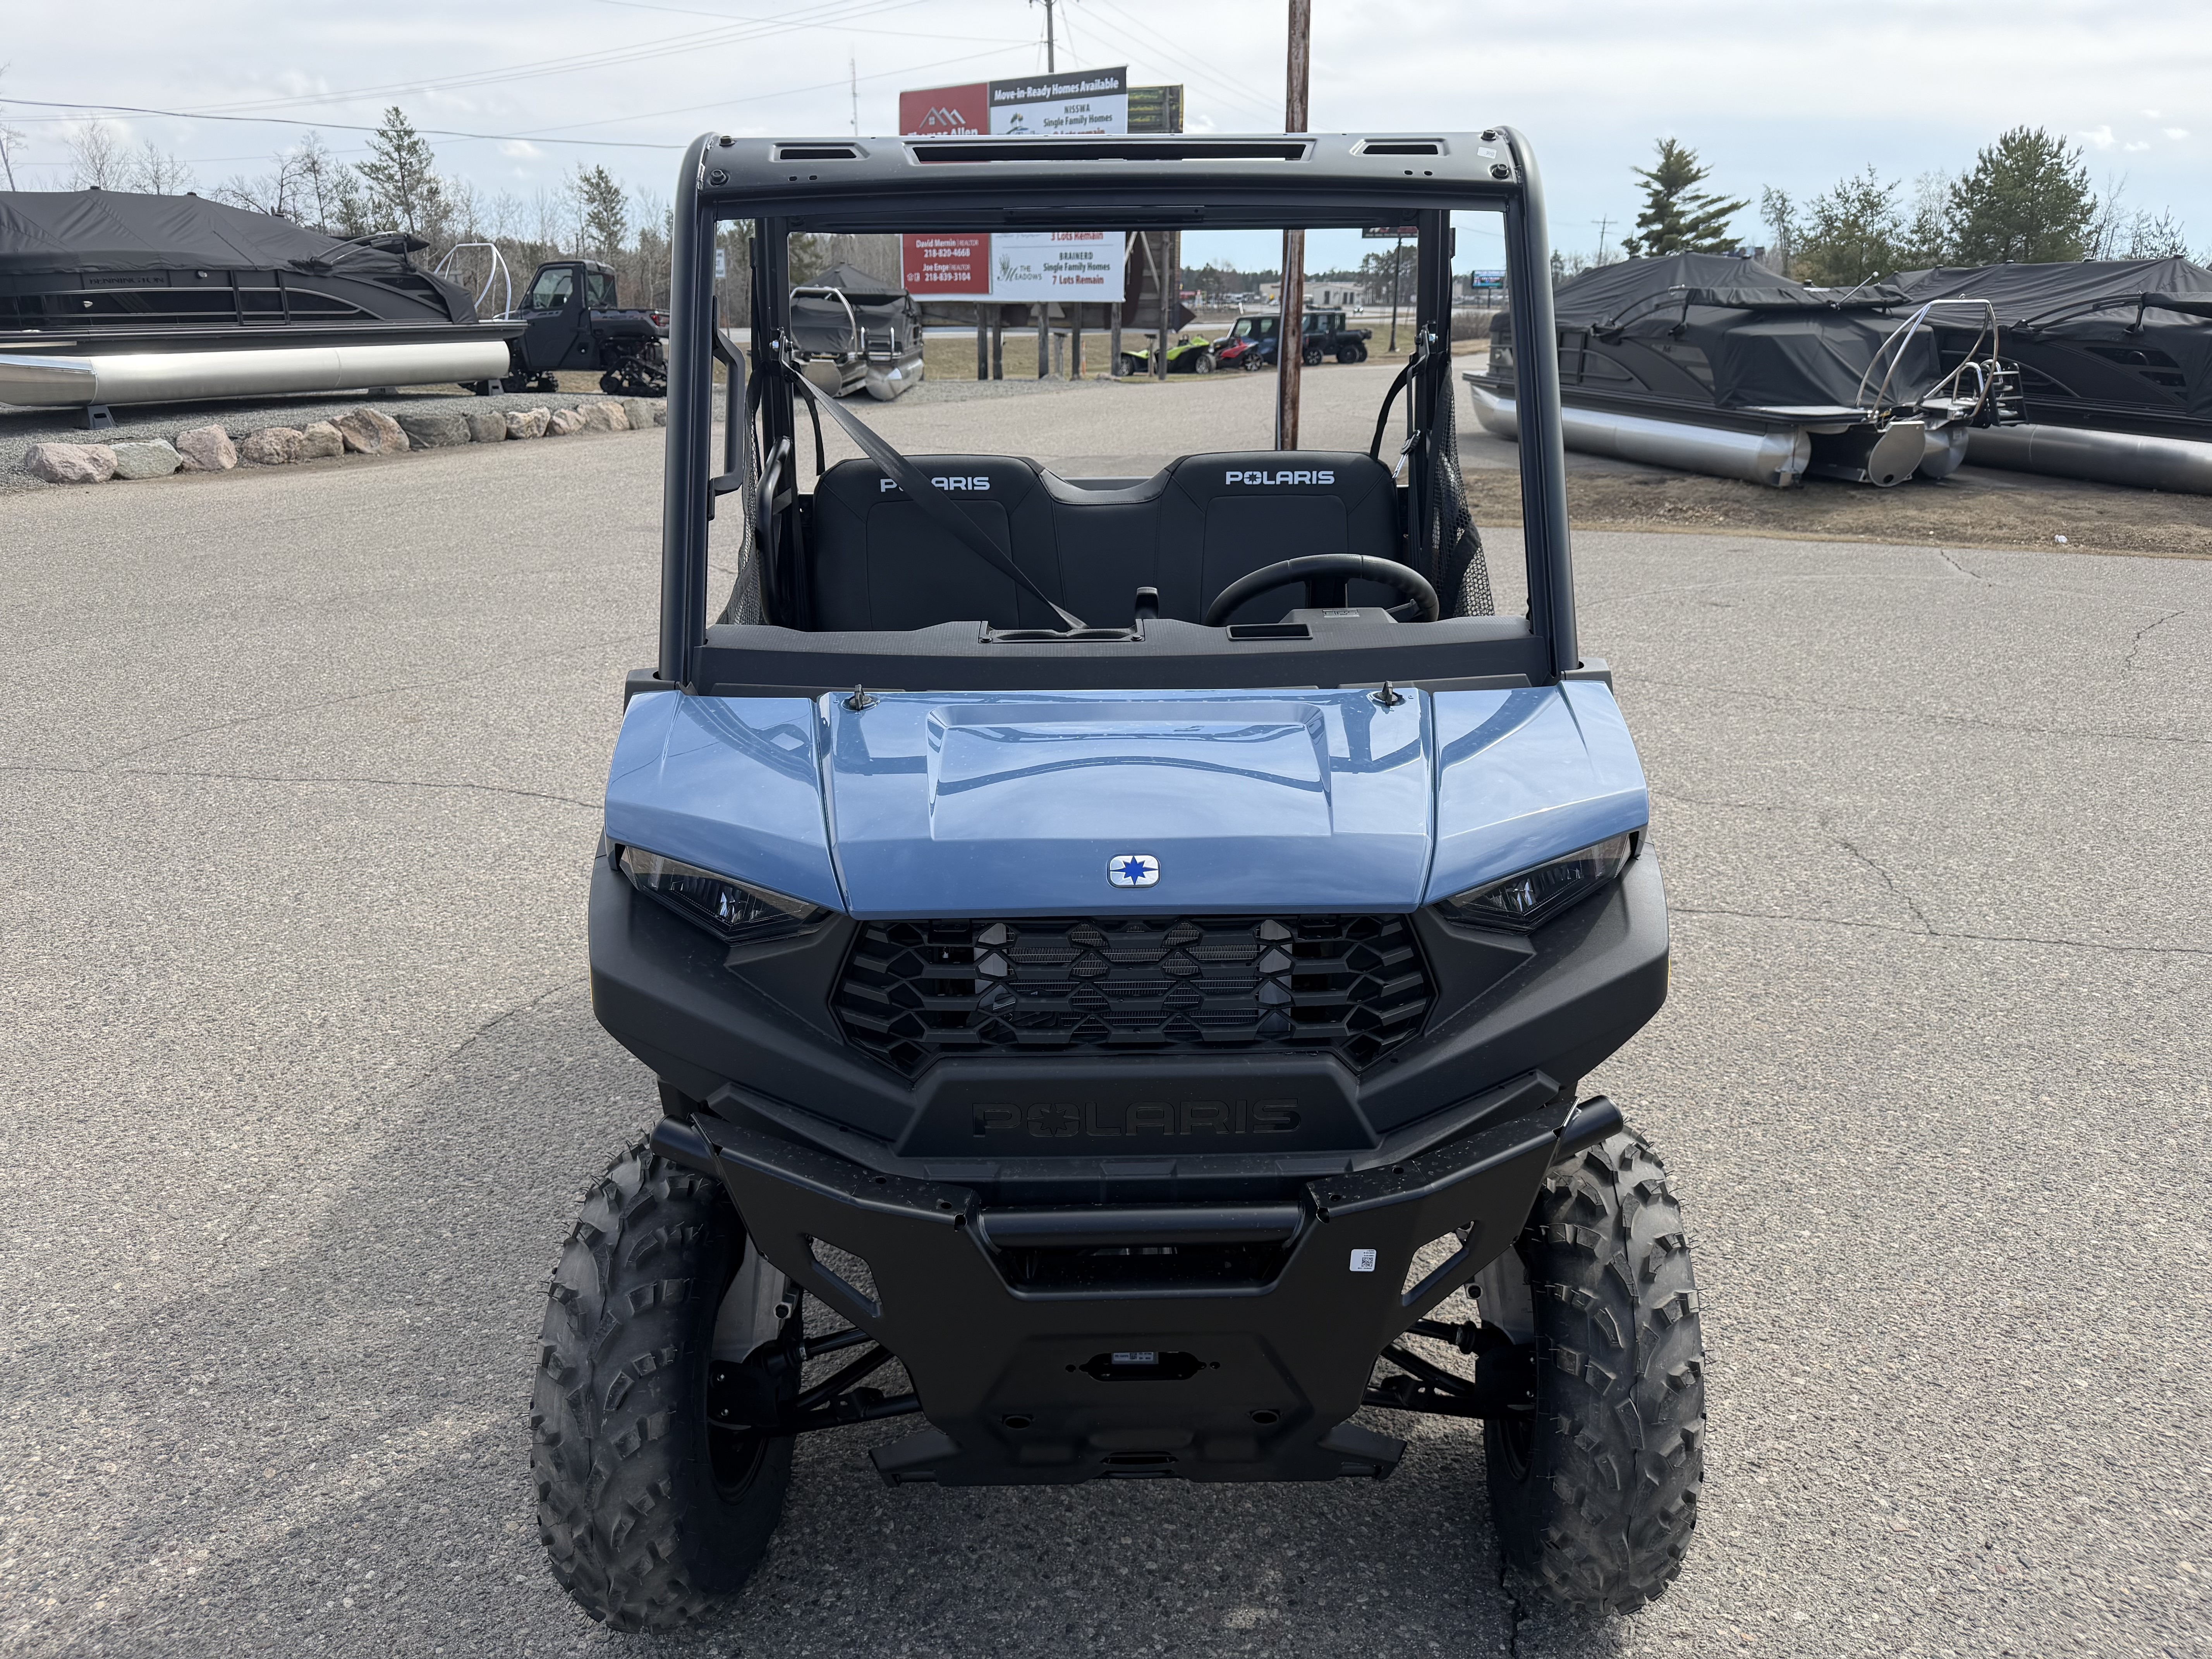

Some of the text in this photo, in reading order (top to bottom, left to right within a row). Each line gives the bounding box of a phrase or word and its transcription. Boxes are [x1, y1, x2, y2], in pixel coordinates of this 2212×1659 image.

[994, 77, 1119, 101] Move-in-Ready Homes Available
[1043, 114, 1113, 128] Single Family Homes
[916, 239, 934, 248] David
[1043, 262, 1111, 273] Single Family Homes
[1059, 274, 1075, 285] Lots
[1075, 274, 1104, 284] Remain
[880, 477, 990, 492] PARIS
[1226, 471, 1335, 485] POLARIS
[972, 1097, 1302, 1137] POLARIS
